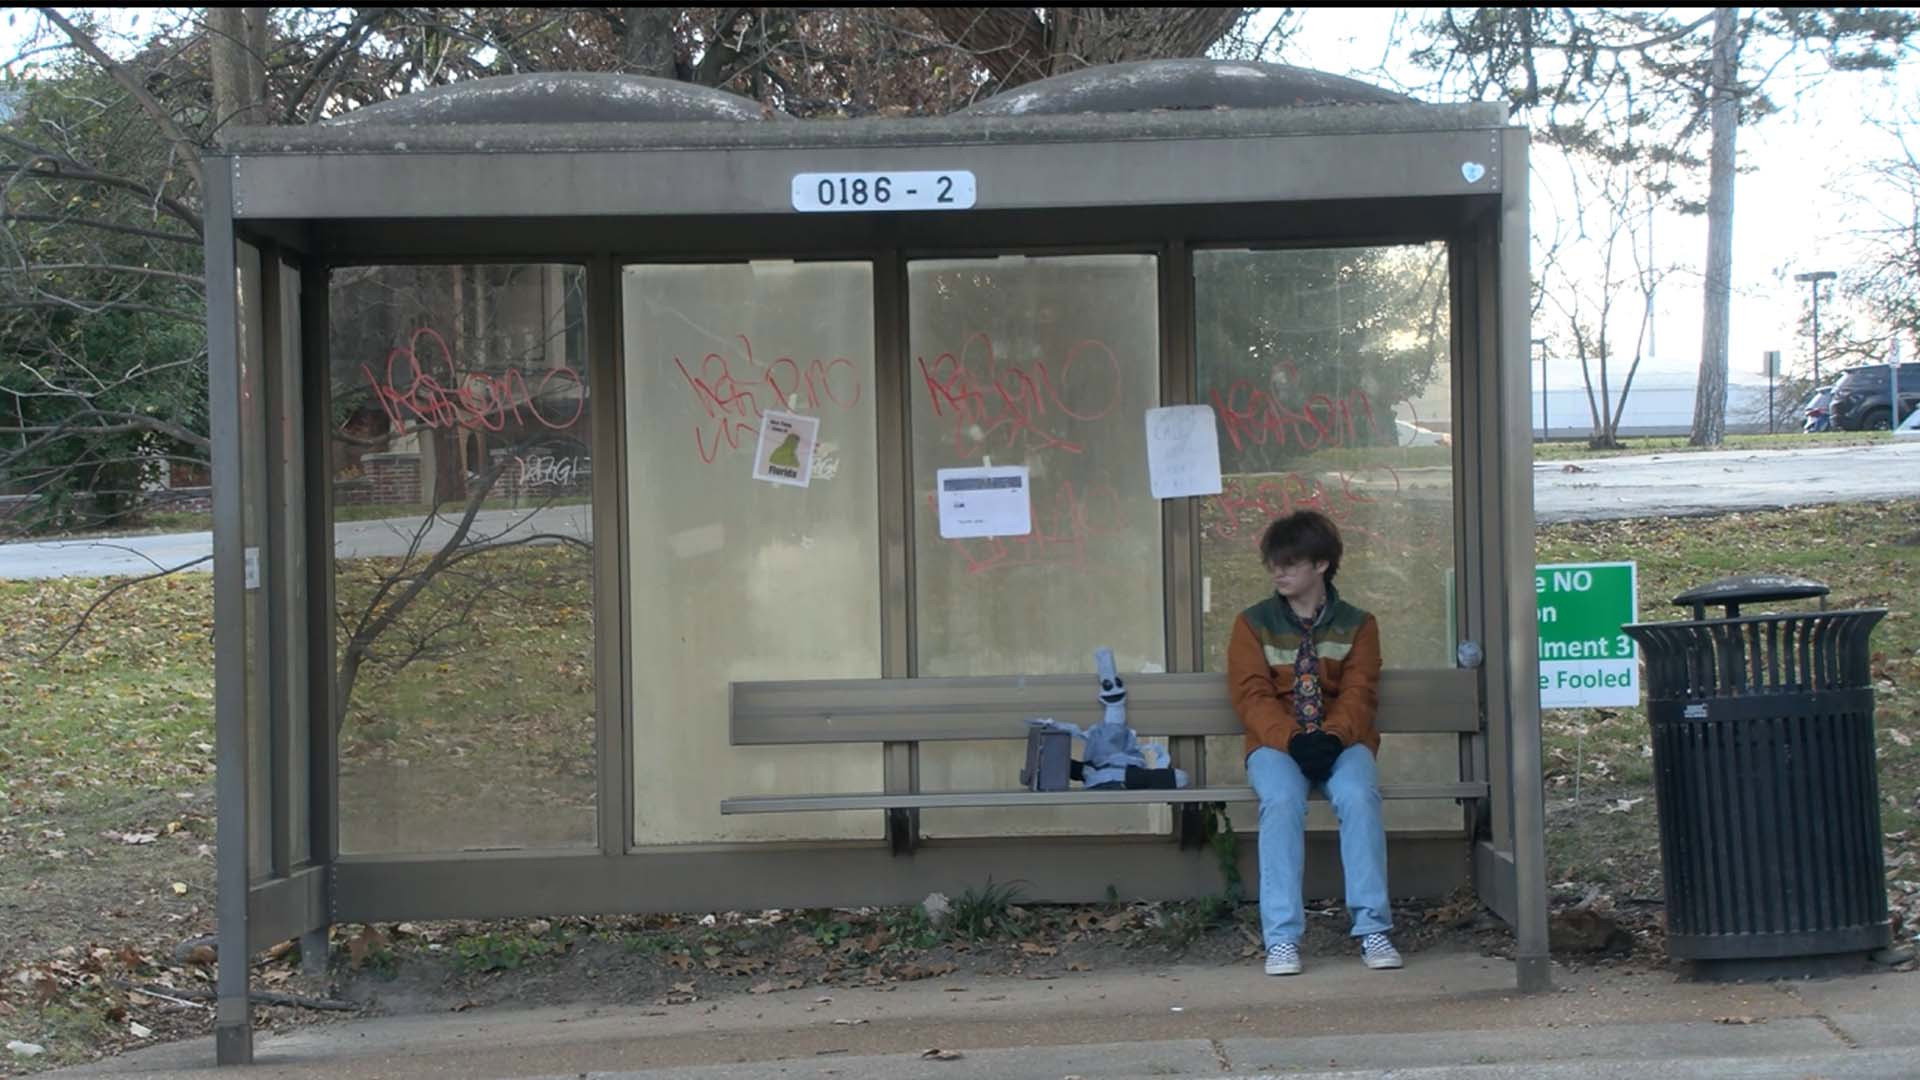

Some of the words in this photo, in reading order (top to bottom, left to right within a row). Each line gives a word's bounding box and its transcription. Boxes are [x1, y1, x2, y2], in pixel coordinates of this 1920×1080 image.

[818, 176, 891, 205] 0186
[937, 176, 954, 203] 2
[768, 465, 797, 478] Florida
[1553, 570, 1592, 592] NO
[1539, 636, 1608, 658] ment
[1616, 635, 1631, 656] 3
[1557, 668, 1631, 688] Fooled
